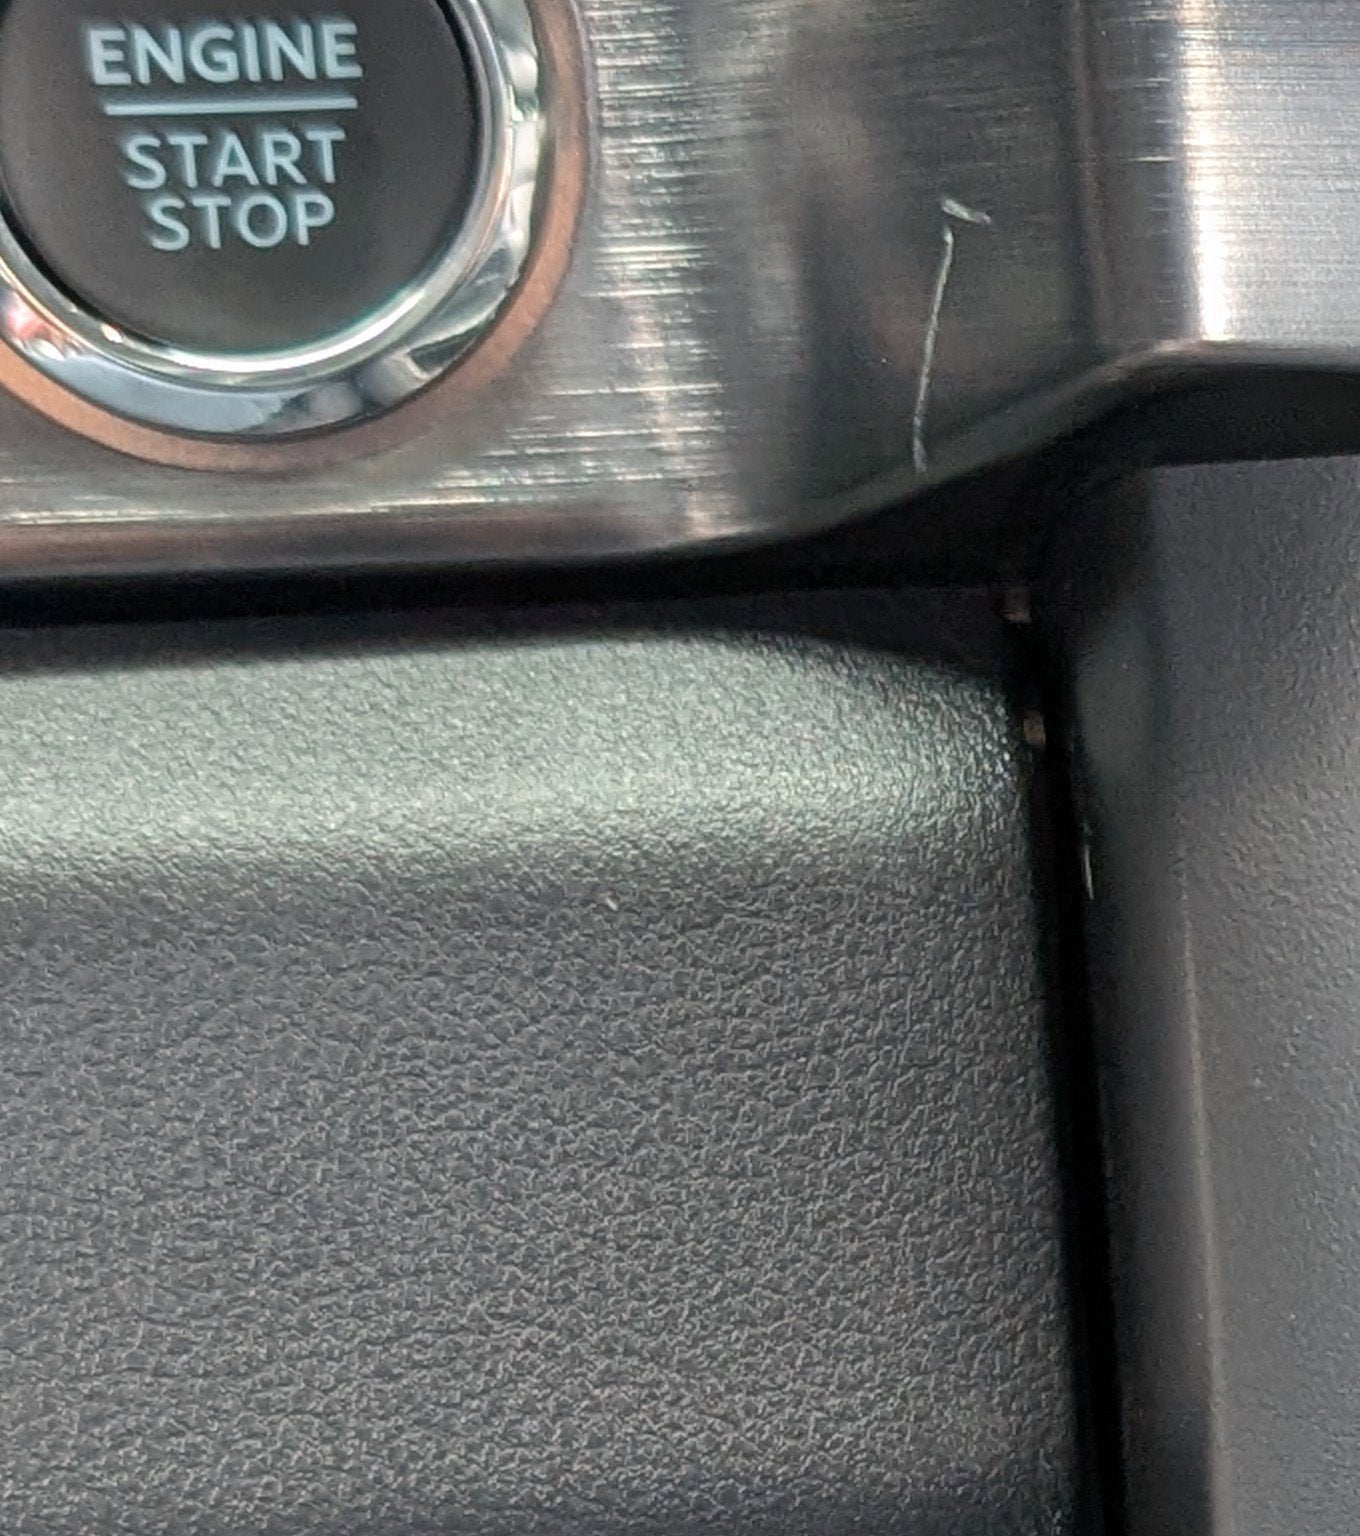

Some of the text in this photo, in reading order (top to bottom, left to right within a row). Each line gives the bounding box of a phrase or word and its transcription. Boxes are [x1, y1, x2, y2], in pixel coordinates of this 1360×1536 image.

[86, 22, 364, 86] ENGINE
[121, 128, 347, 191] START
[144, 190, 335, 252] STOP
